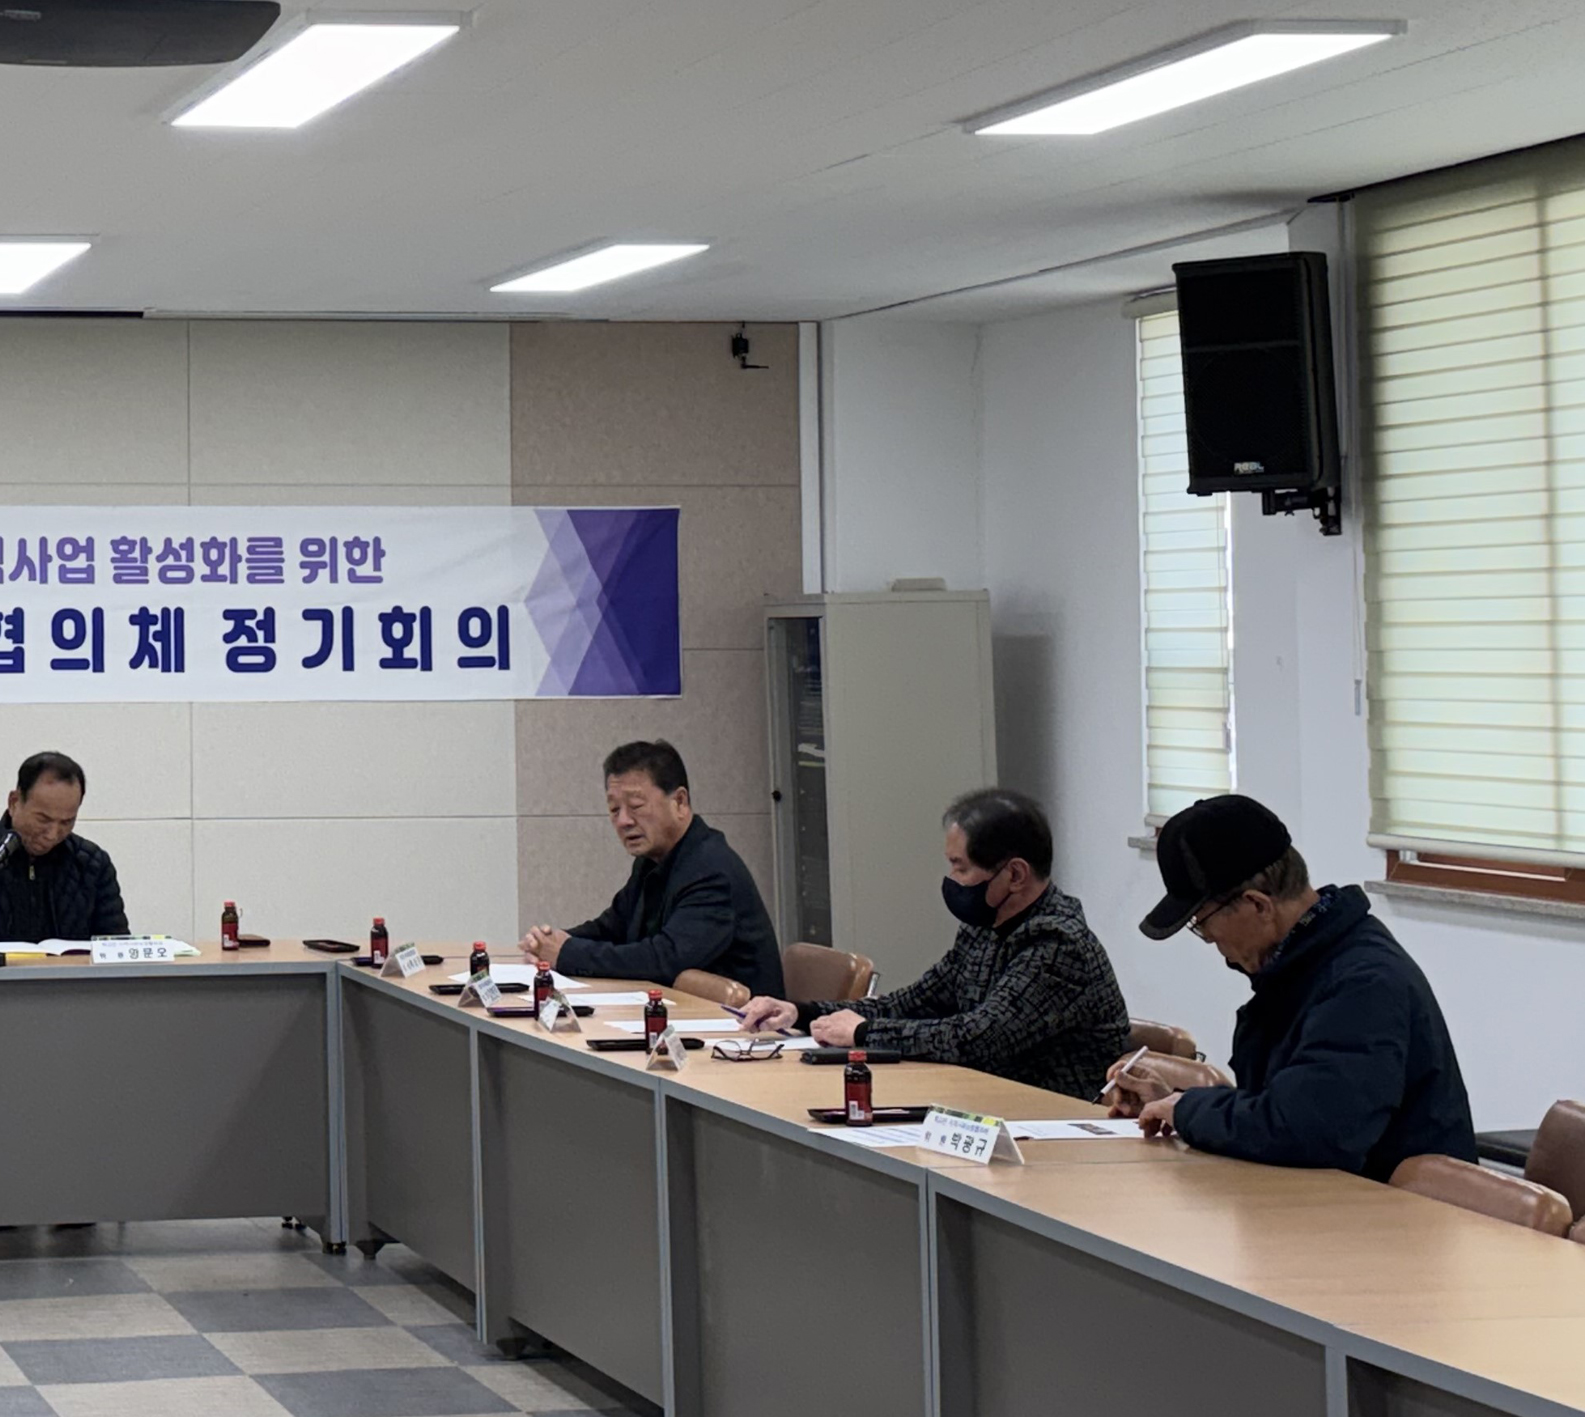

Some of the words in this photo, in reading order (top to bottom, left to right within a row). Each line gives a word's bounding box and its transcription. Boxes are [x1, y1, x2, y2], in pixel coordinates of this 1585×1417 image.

[109, 535, 286, 585] 활성화를
[299, 535, 386, 585] 위한
[222, 604, 511, 673] 정기회의
